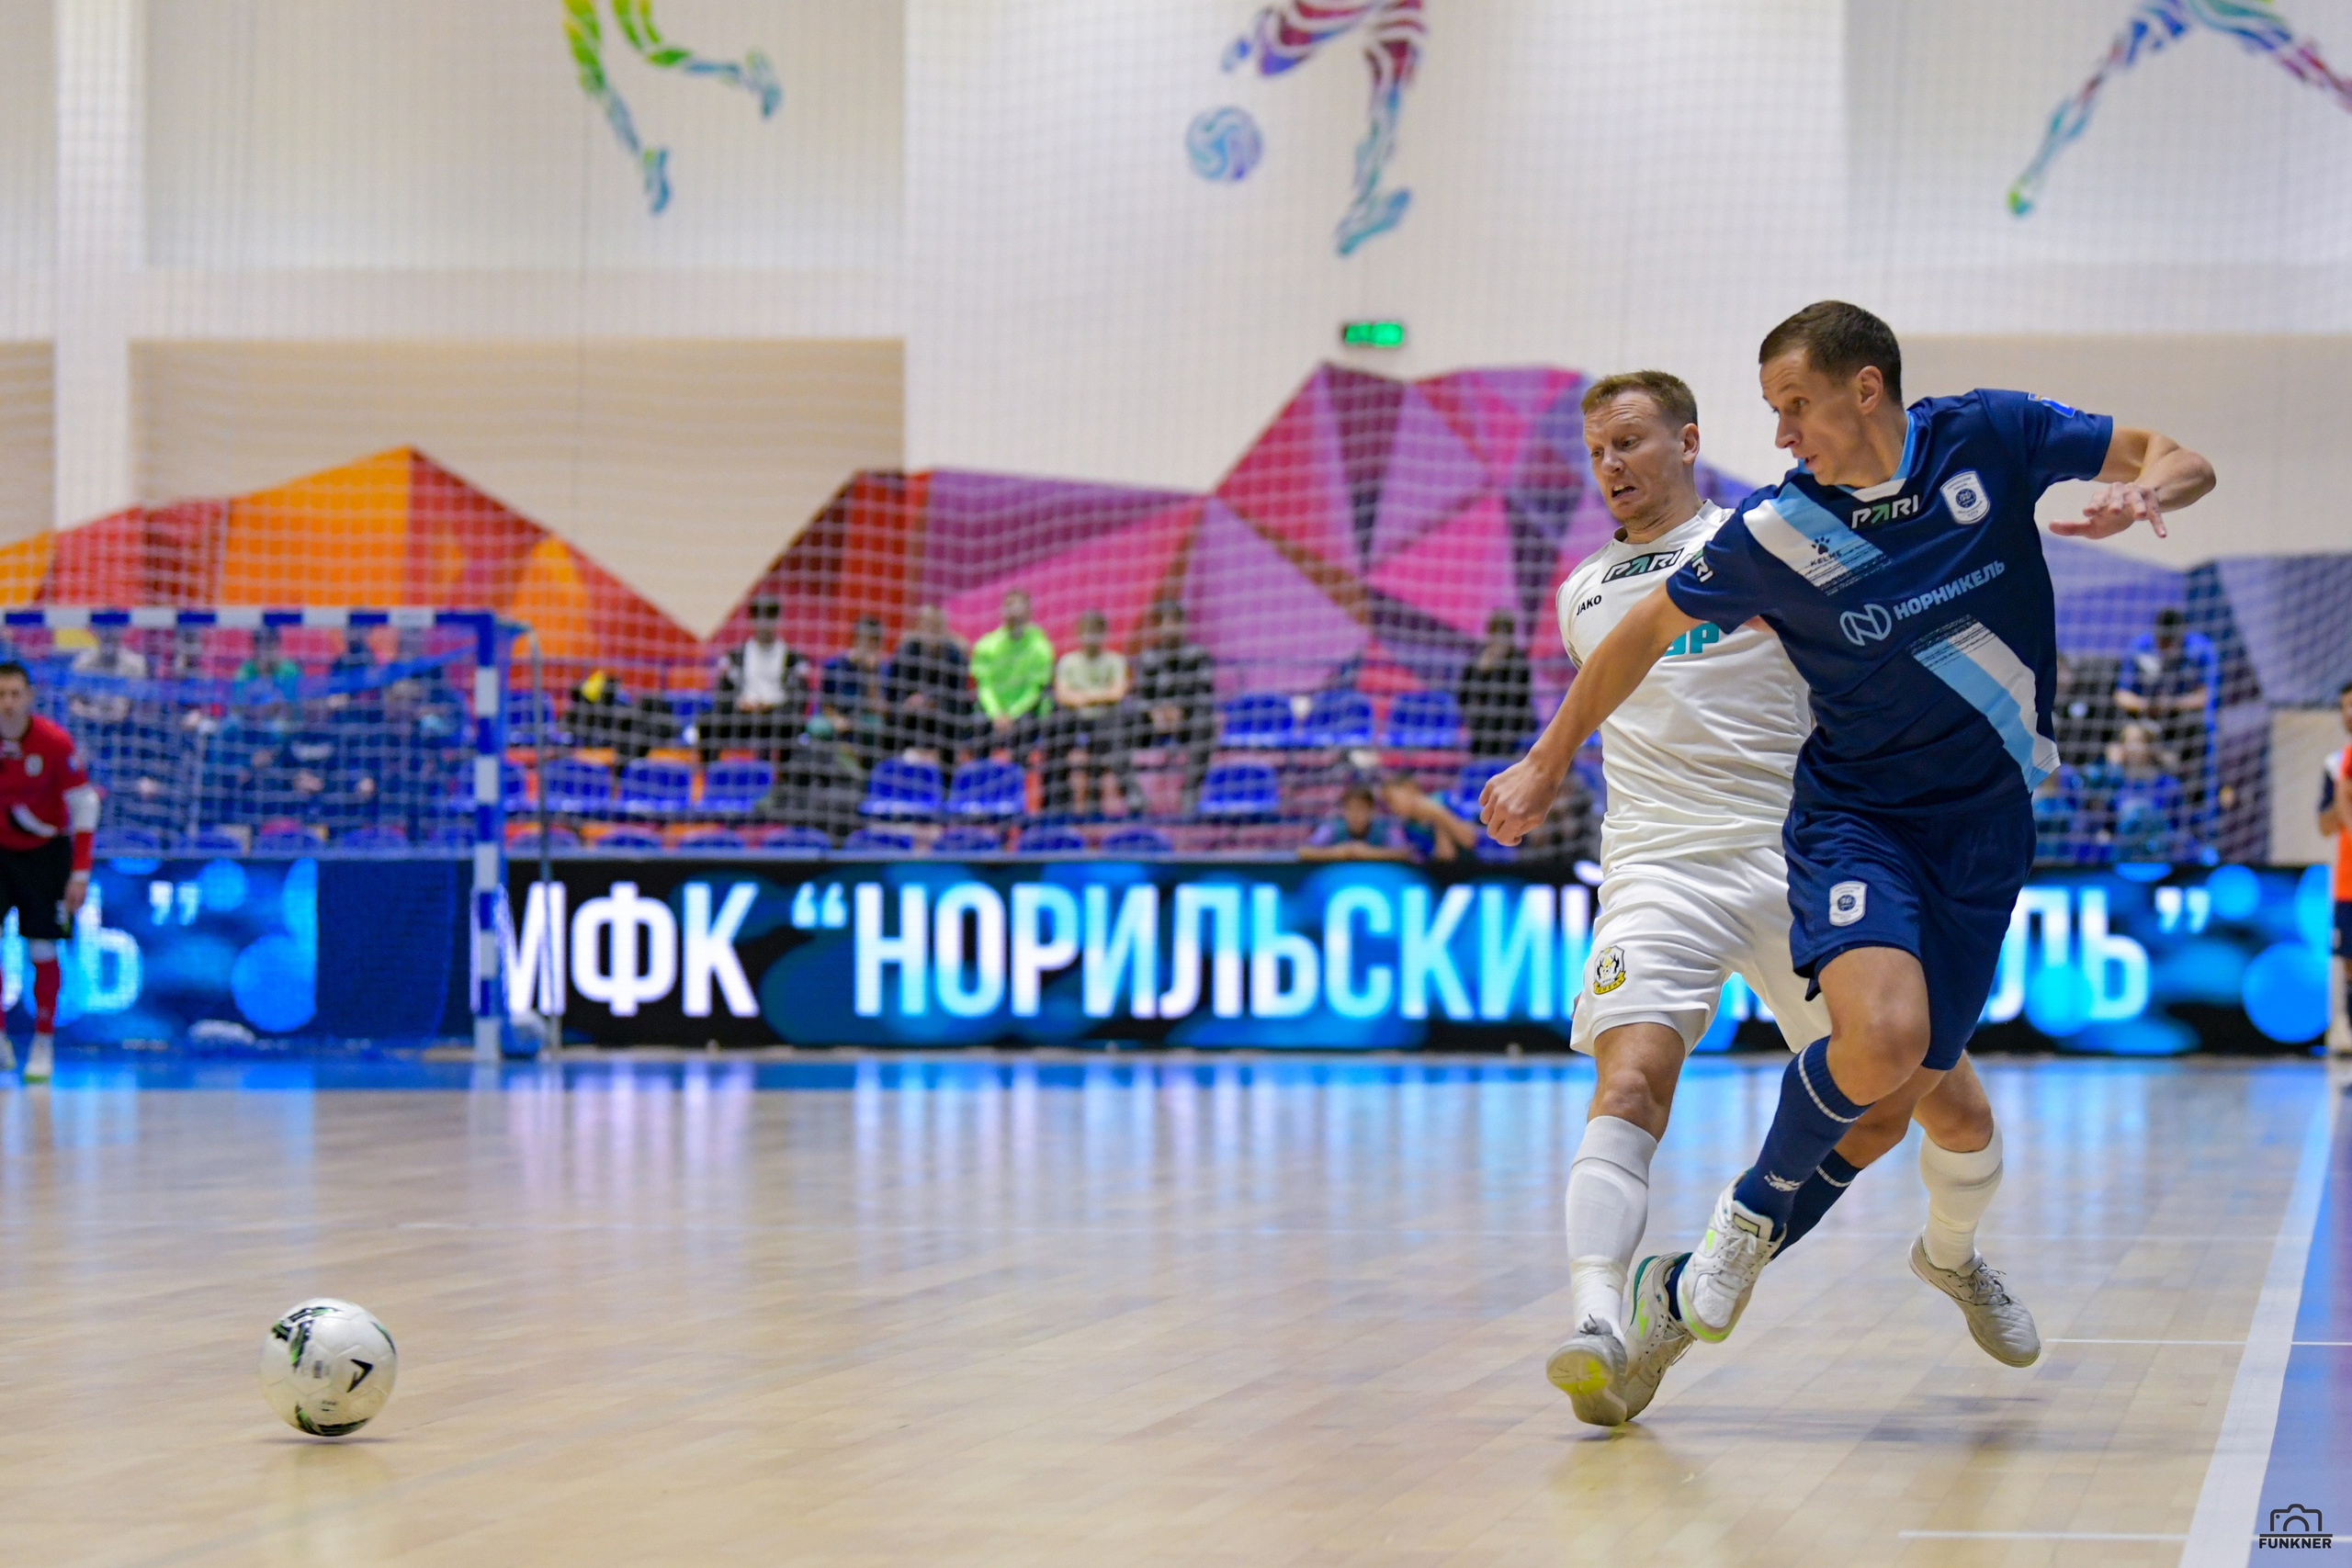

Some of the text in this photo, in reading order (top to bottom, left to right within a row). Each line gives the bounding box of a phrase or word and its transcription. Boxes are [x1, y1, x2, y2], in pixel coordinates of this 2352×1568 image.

[1851, 494, 1919, 529] PARI
[1602, 548, 1683, 582] PARI
[1576, 594, 1602, 616] JAKO
[1893, 559, 2006, 621] НОРНИКЕЛЬ
[469, 882, 759, 1018] МФК
